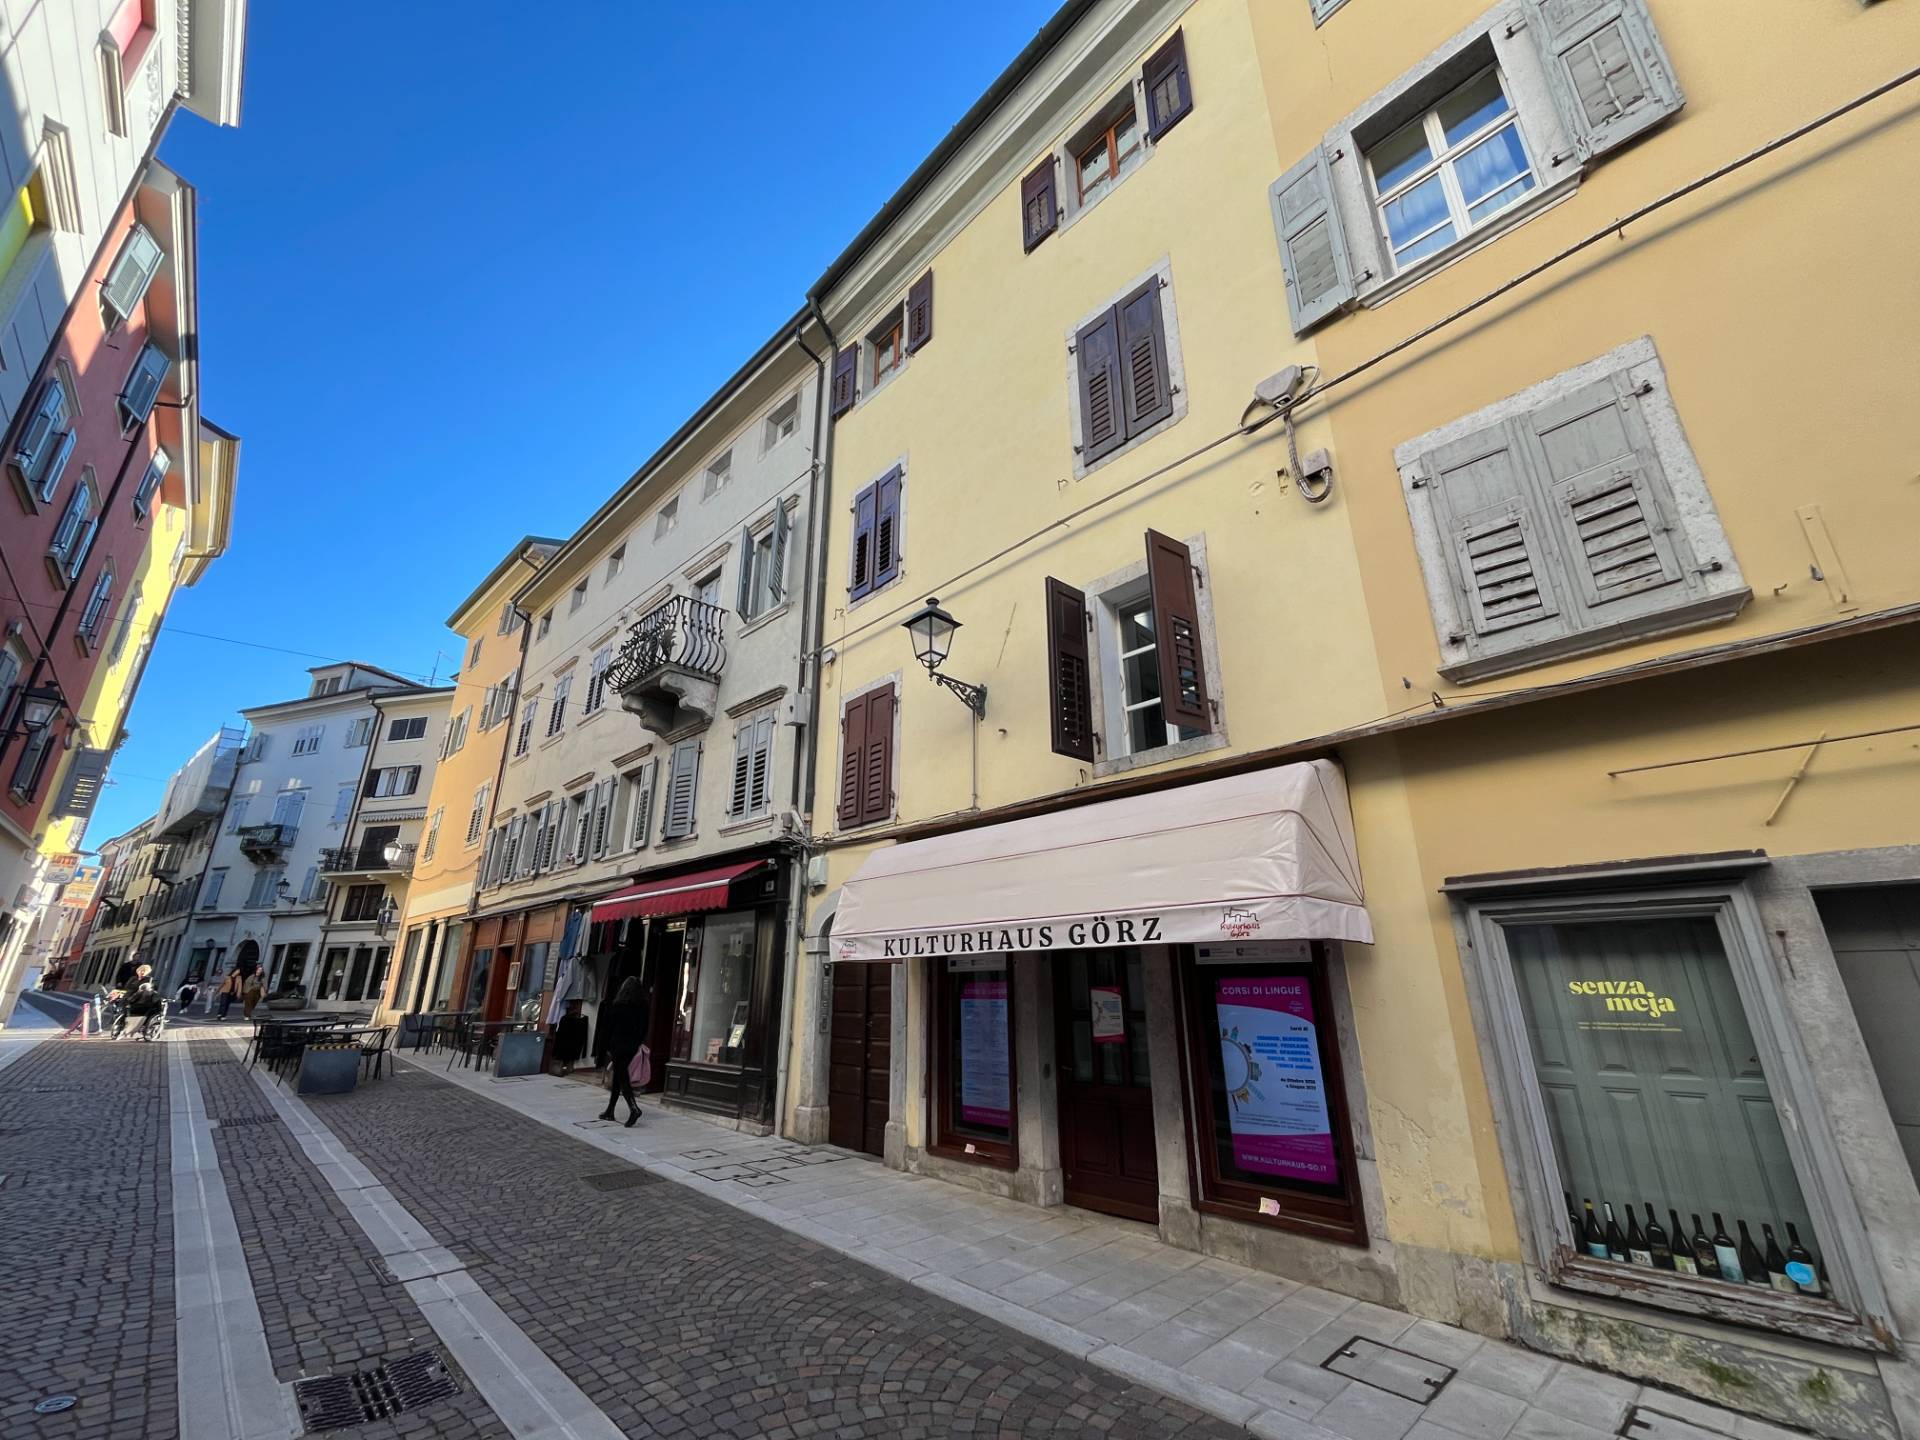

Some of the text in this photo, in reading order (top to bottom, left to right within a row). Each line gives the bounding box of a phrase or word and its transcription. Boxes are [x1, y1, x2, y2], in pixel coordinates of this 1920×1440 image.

[884, 915, 1162, 956] KULTURHAUS GÖRZ
[1222, 986, 1302, 995] CORSI DI LINGUE
[1568, 980, 1646, 995] senza
[1605, 991, 1677, 1018] meja
